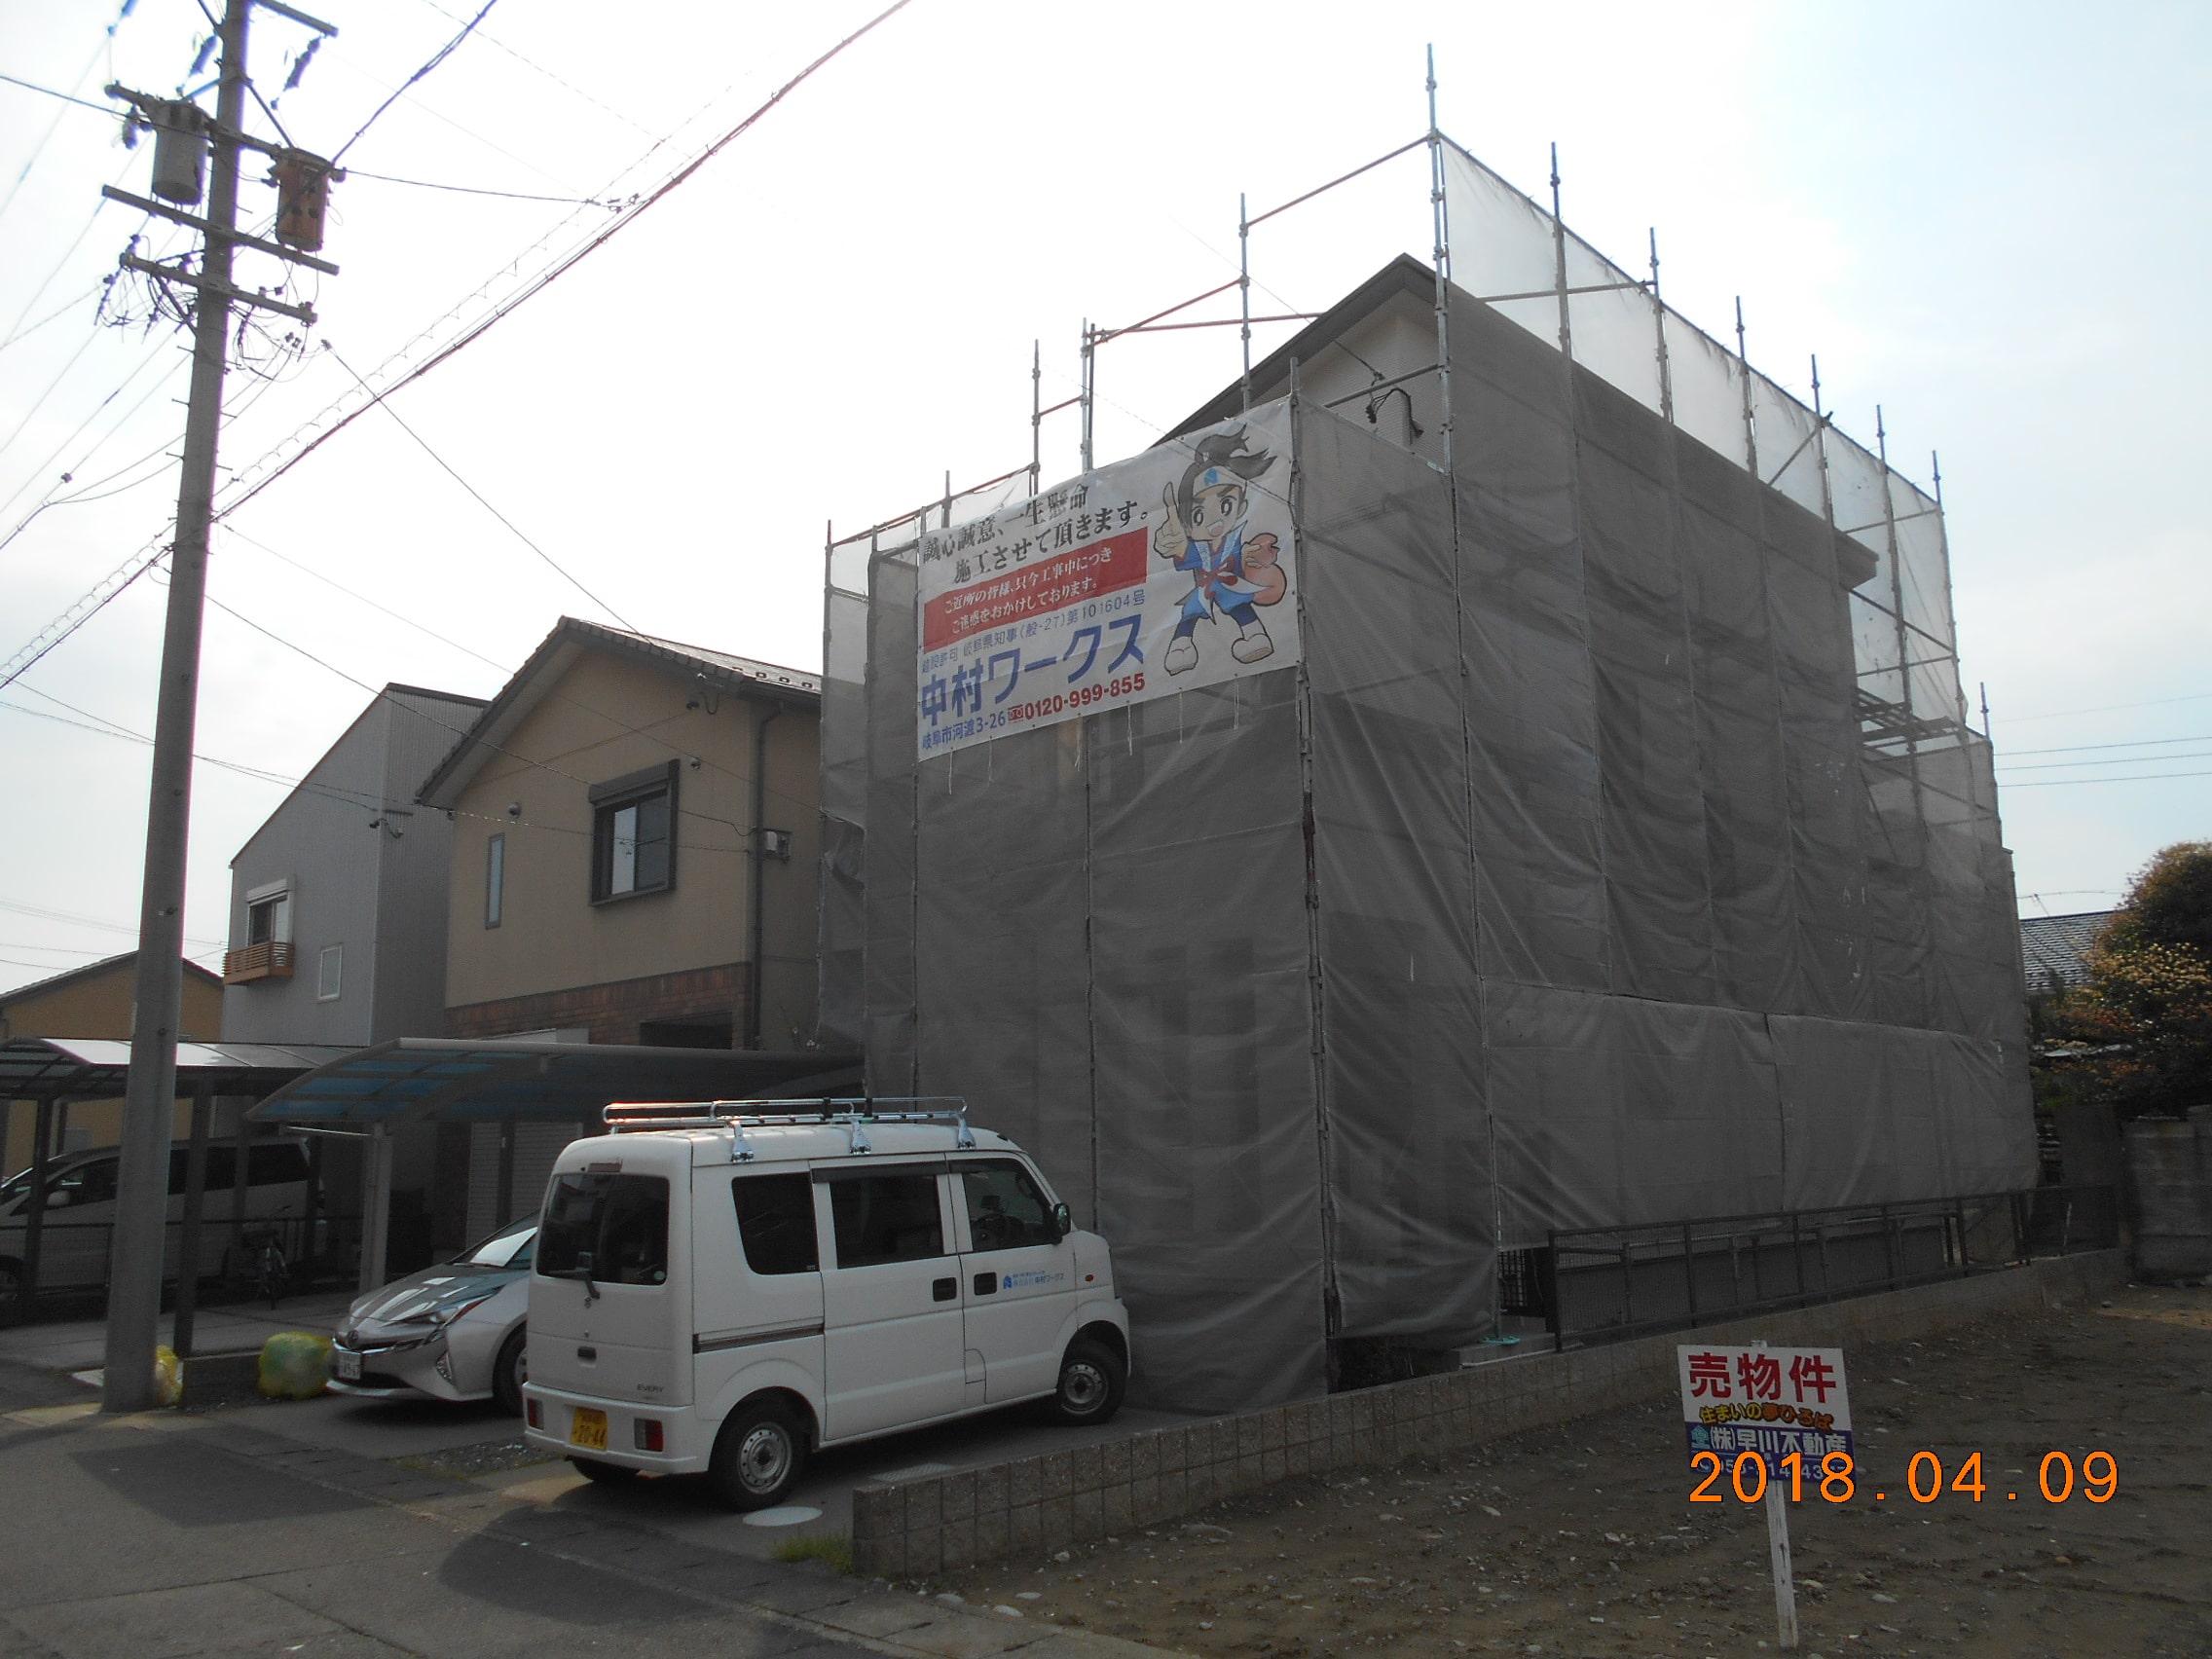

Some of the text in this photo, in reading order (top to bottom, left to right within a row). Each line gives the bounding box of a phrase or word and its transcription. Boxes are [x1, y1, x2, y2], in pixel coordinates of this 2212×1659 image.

[954, 500, 1148, 584] 施工させて頂きます。
[921, 613, 1144, 726] 中村ワークス
[1025, 672, 1146, 720] 0120-999-855
[1688, 1352, 1837, 1403] 売物件
